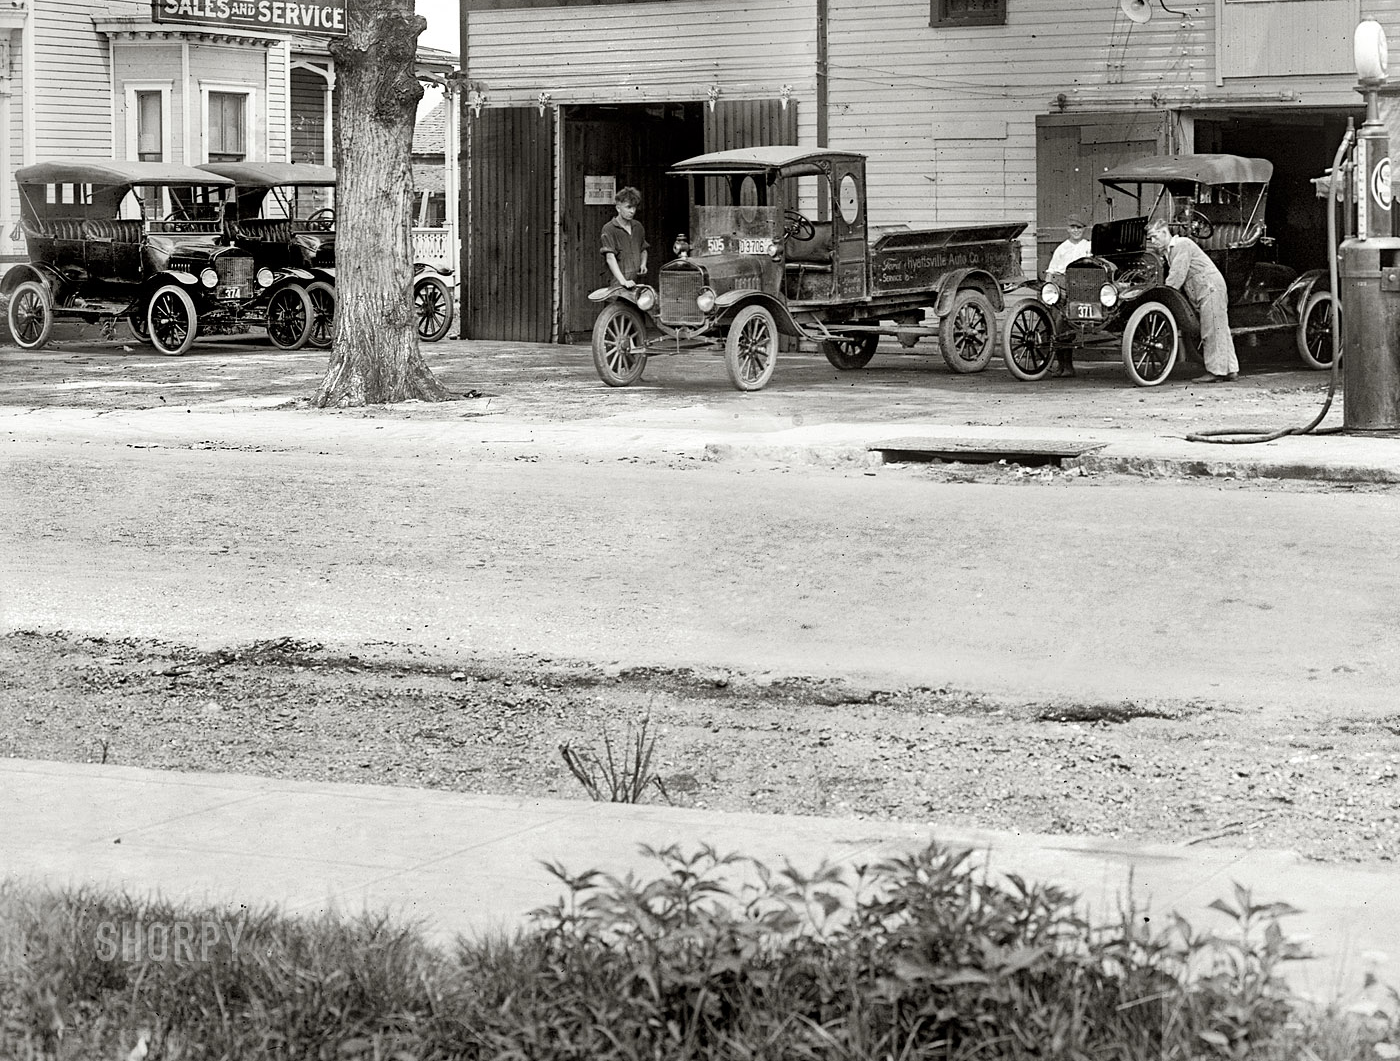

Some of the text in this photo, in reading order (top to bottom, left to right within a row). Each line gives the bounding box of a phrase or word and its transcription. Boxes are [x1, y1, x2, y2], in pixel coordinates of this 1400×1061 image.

[231, 1, 256, 17] AND
[257, 0, 345, 30] SERVICE
[707, 238, 725, 251] 505
[1078, 306, 1093, 318] 371
